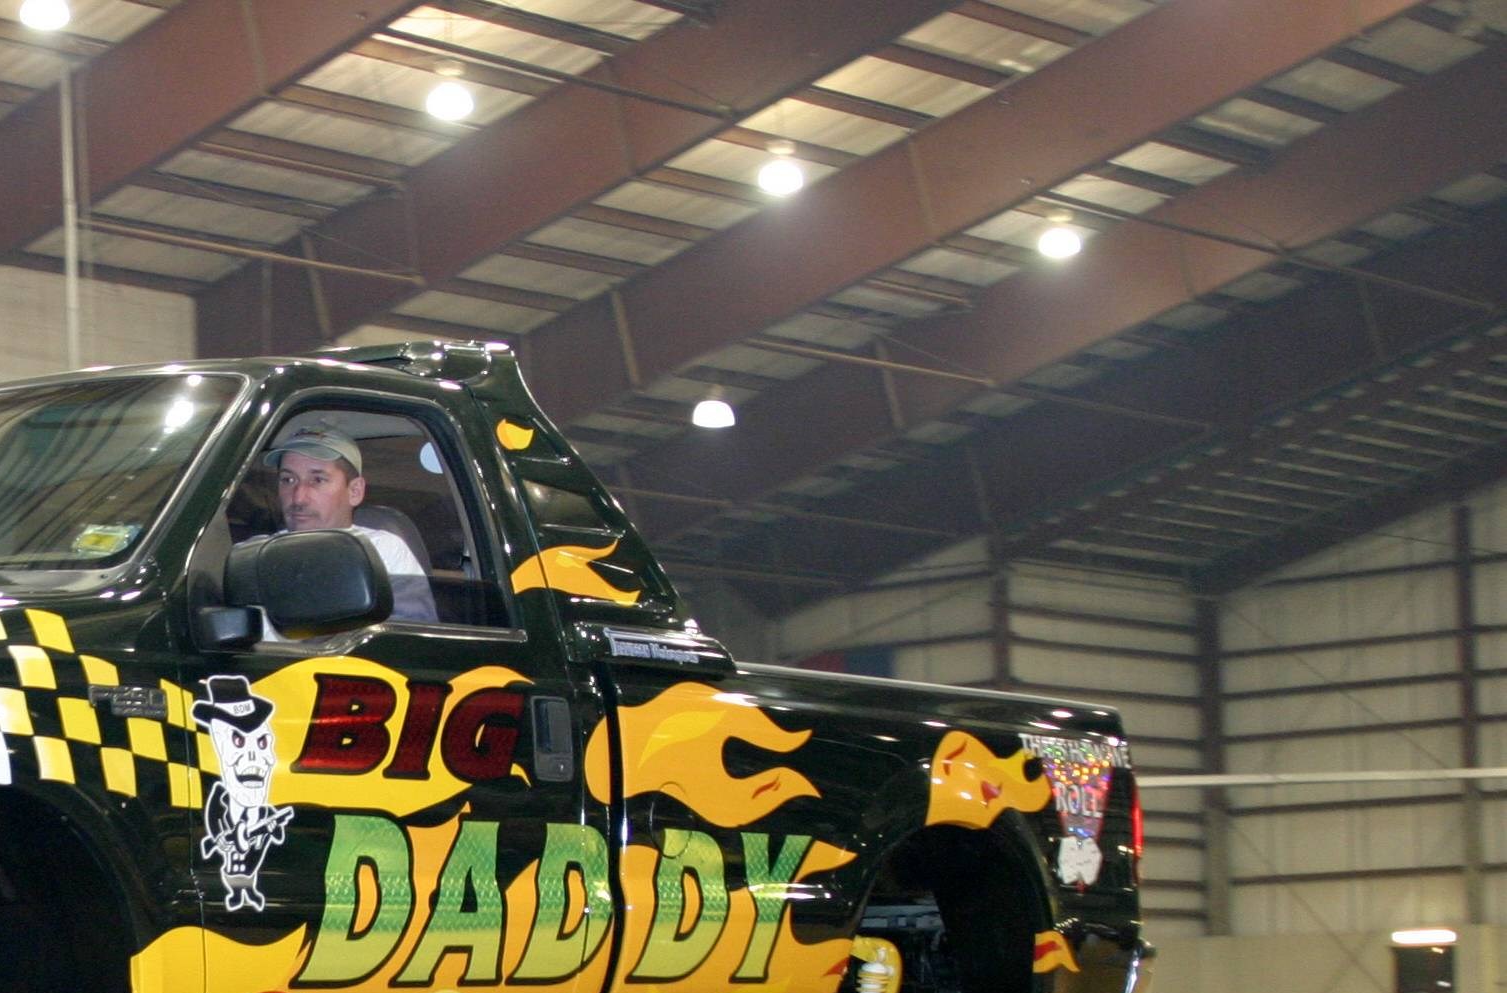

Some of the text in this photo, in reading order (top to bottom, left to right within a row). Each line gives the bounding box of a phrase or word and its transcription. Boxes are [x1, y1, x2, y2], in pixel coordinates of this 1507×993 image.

[292, 674, 525, 780] BIG
[1054, 782, 1103, 817] ROLL
[290, 812, 816, 989] DADDY
